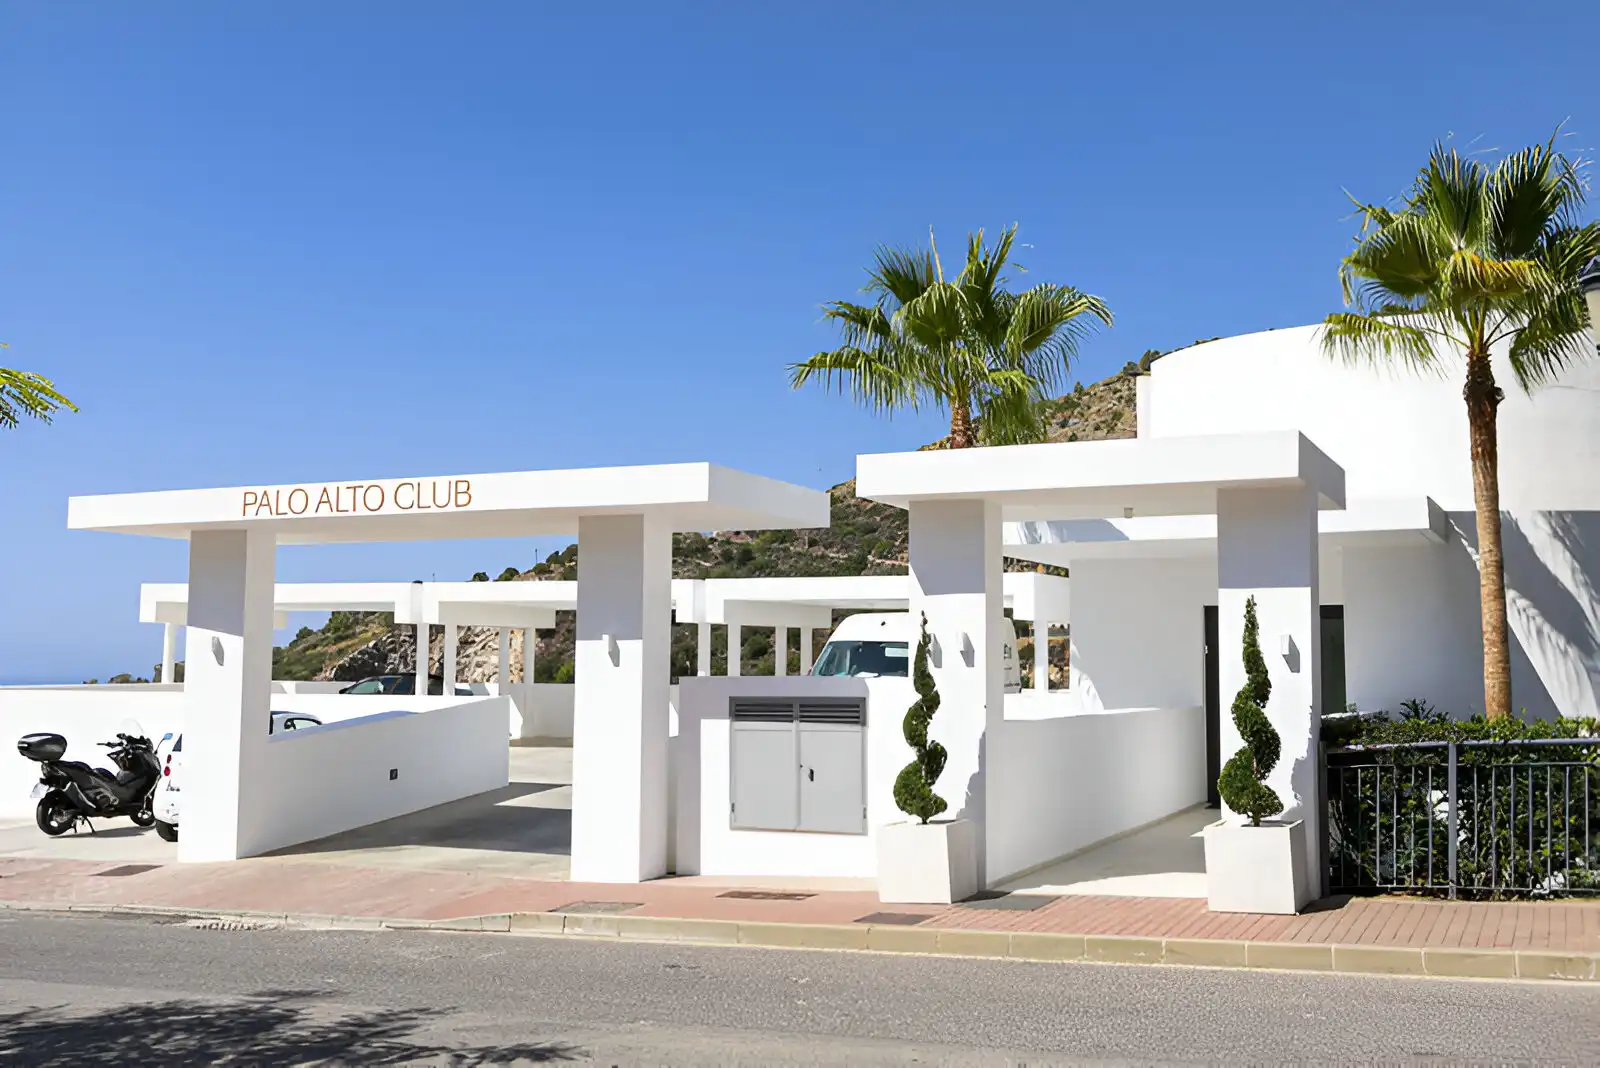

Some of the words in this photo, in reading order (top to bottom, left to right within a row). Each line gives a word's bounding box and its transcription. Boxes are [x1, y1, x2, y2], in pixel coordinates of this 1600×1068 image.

[242, 488, 309, 517] PALO
[315, 485, 385, 514] ALTO
[394, 480, 472, 510] CLUB
